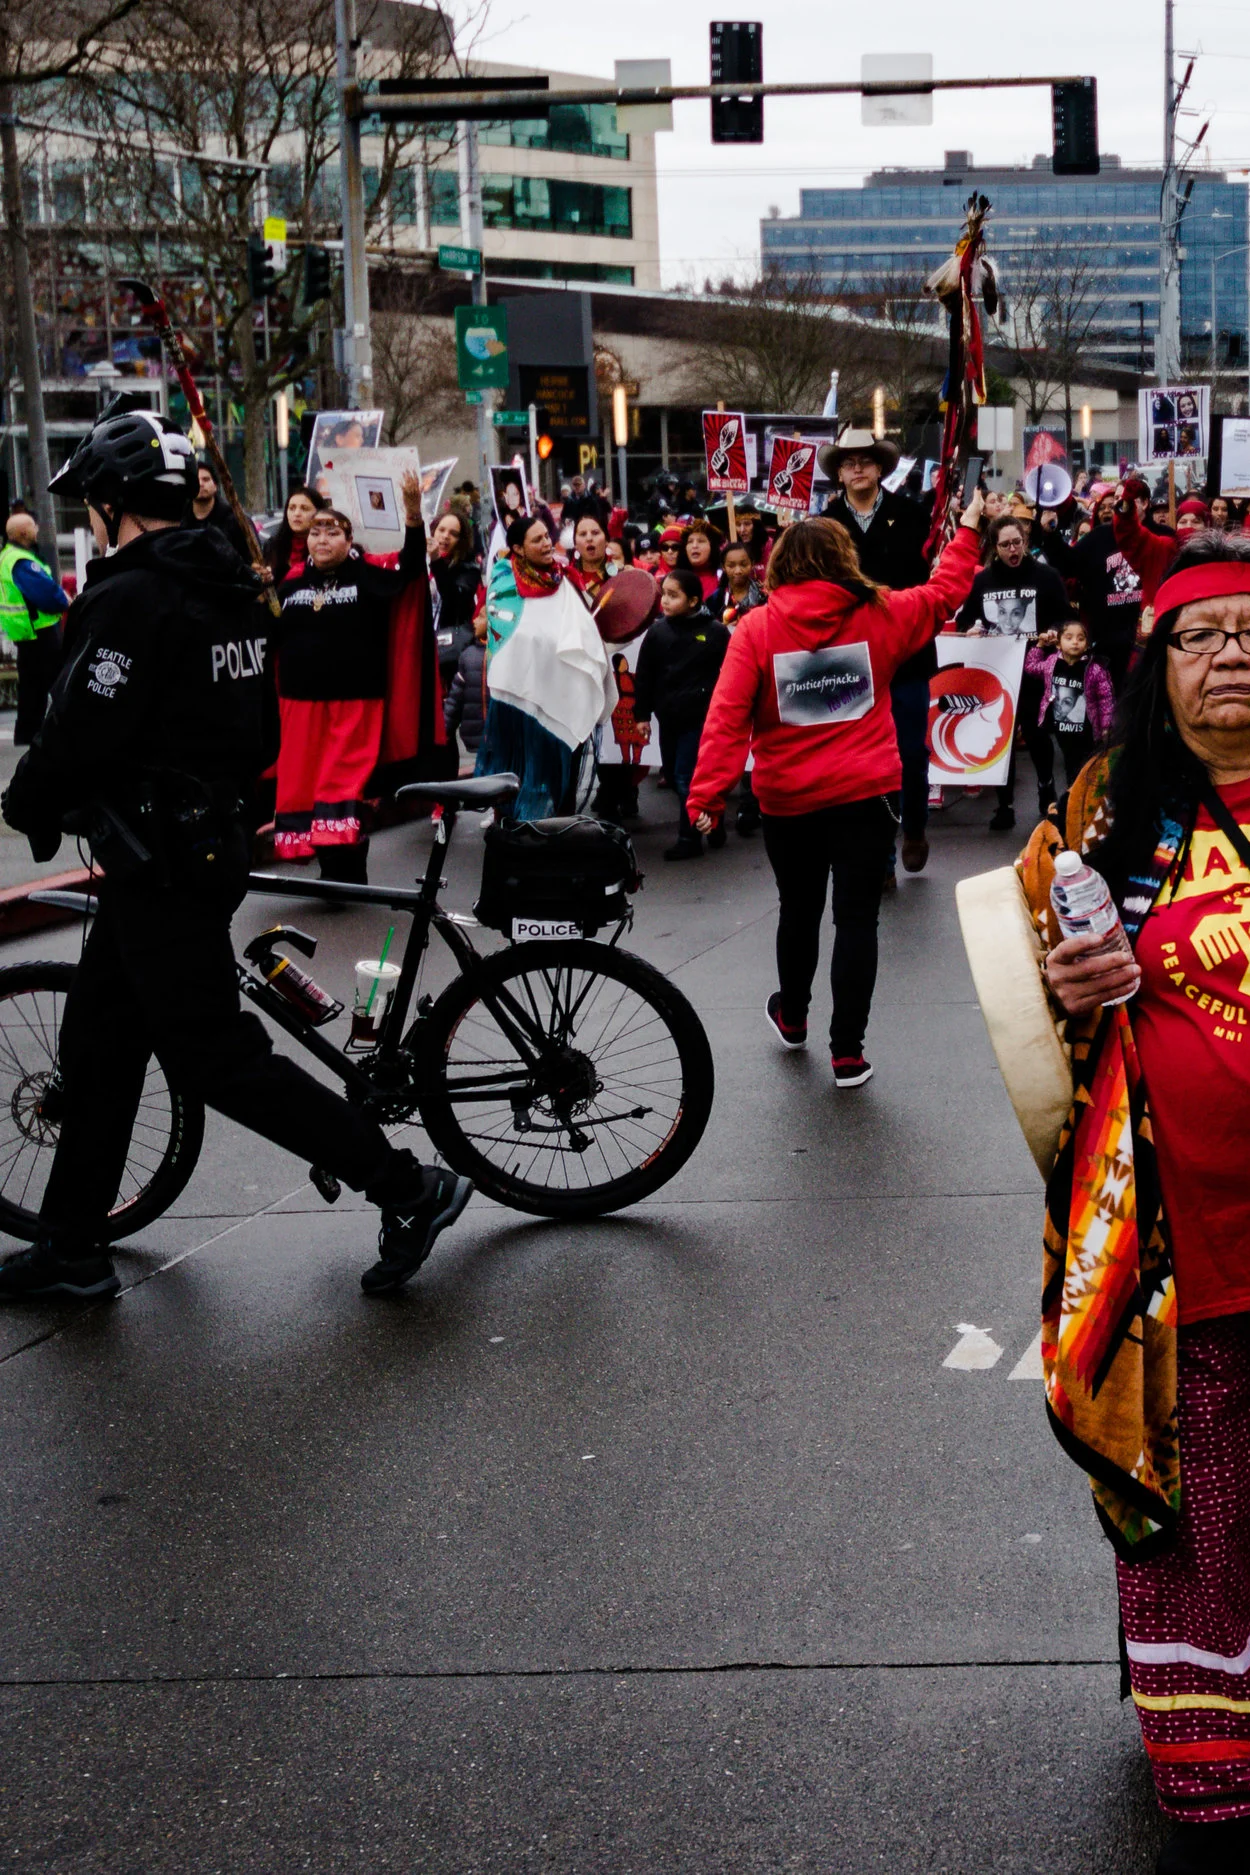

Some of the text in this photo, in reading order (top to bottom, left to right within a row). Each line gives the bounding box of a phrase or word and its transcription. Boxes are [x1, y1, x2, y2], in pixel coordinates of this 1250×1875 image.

[496, 412, 508, 424] 5th
[579, 444, 591, 475] P
[983, 588, 1037, 601] JUSTICE FOR
[95, 647, 133, 670] SEATTLE
[212, 638, 267, 683] POLIE
[87, 679, 117, 698] POLICE
[1059, 722, 1084, 732] DAVIS
[517, 923, 578, 937] POLICE
[1161, 942, 1247, 1025] PEACEFUL
[1213, 1025, 1242, 1042] MNI
